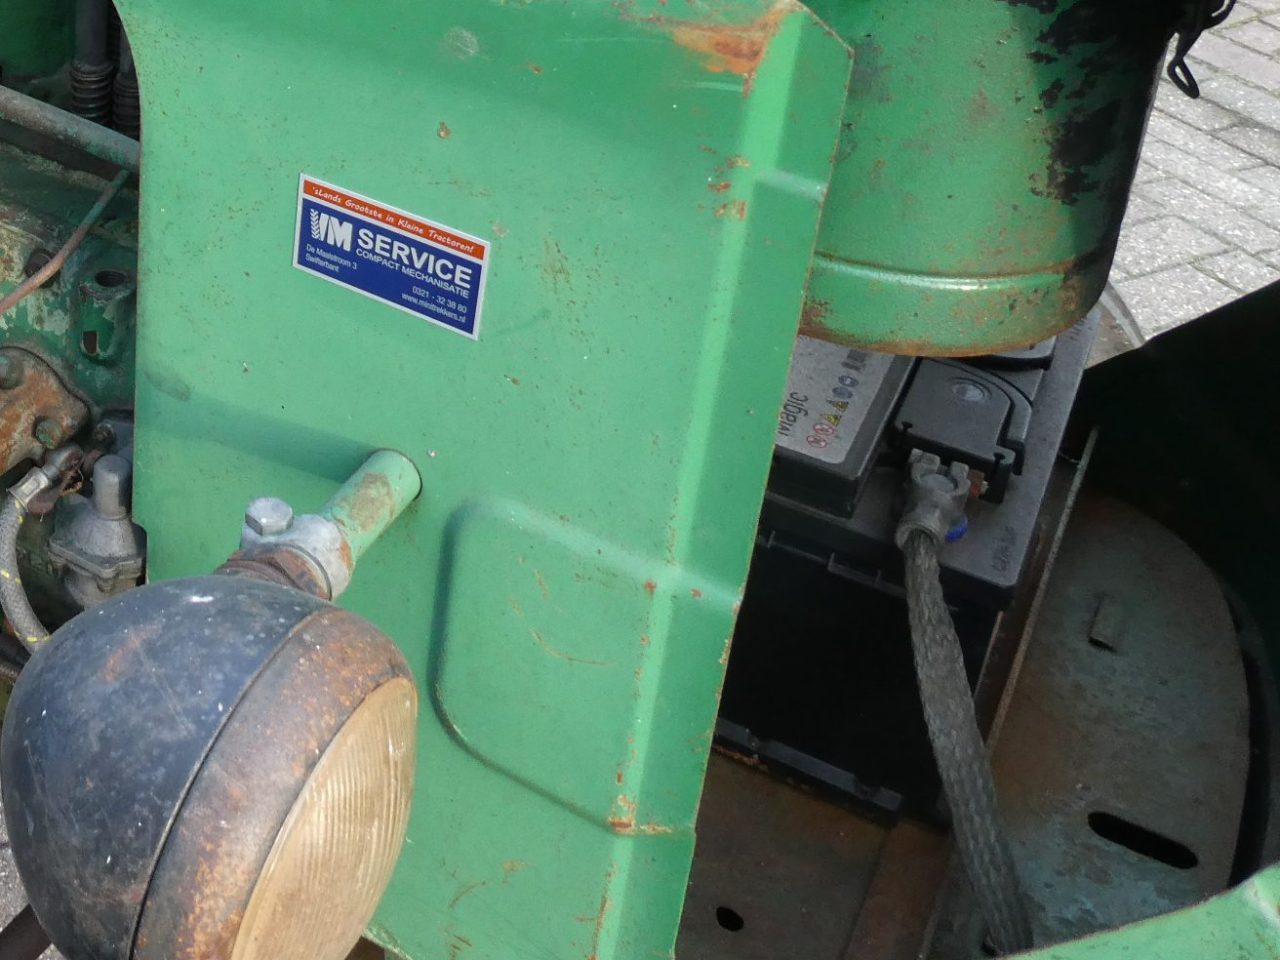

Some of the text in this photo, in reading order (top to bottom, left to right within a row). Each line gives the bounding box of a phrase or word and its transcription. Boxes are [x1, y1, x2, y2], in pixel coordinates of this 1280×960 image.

[344, 199, 383, 220] Grootste
[385, 214, 395, 223] in
[397, 218, 424, 234] Kleine
[428, 229, 475, 253] Tractoren!
[355, 248, 471, 300] COMPACT MECHANISATIE
[357, 227, 472, 289] SERVICE
[412, 285, 430, 299] 0321
